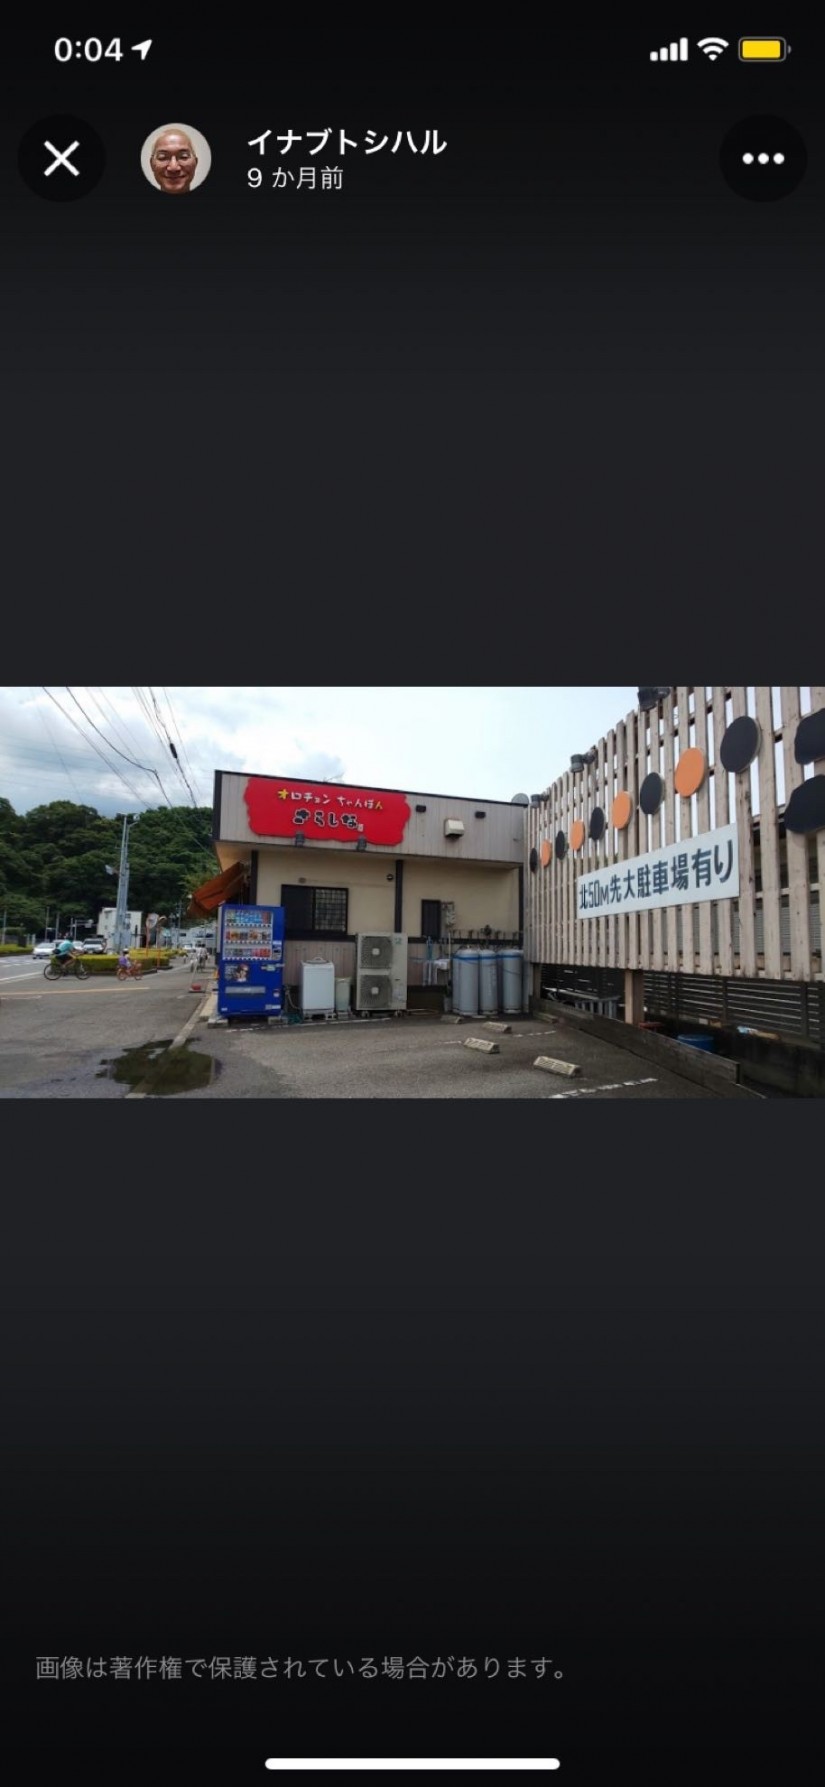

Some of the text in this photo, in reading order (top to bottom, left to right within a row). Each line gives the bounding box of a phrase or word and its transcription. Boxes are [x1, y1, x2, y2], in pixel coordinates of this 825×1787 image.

[277, 788, 331, 805] オロチョン
